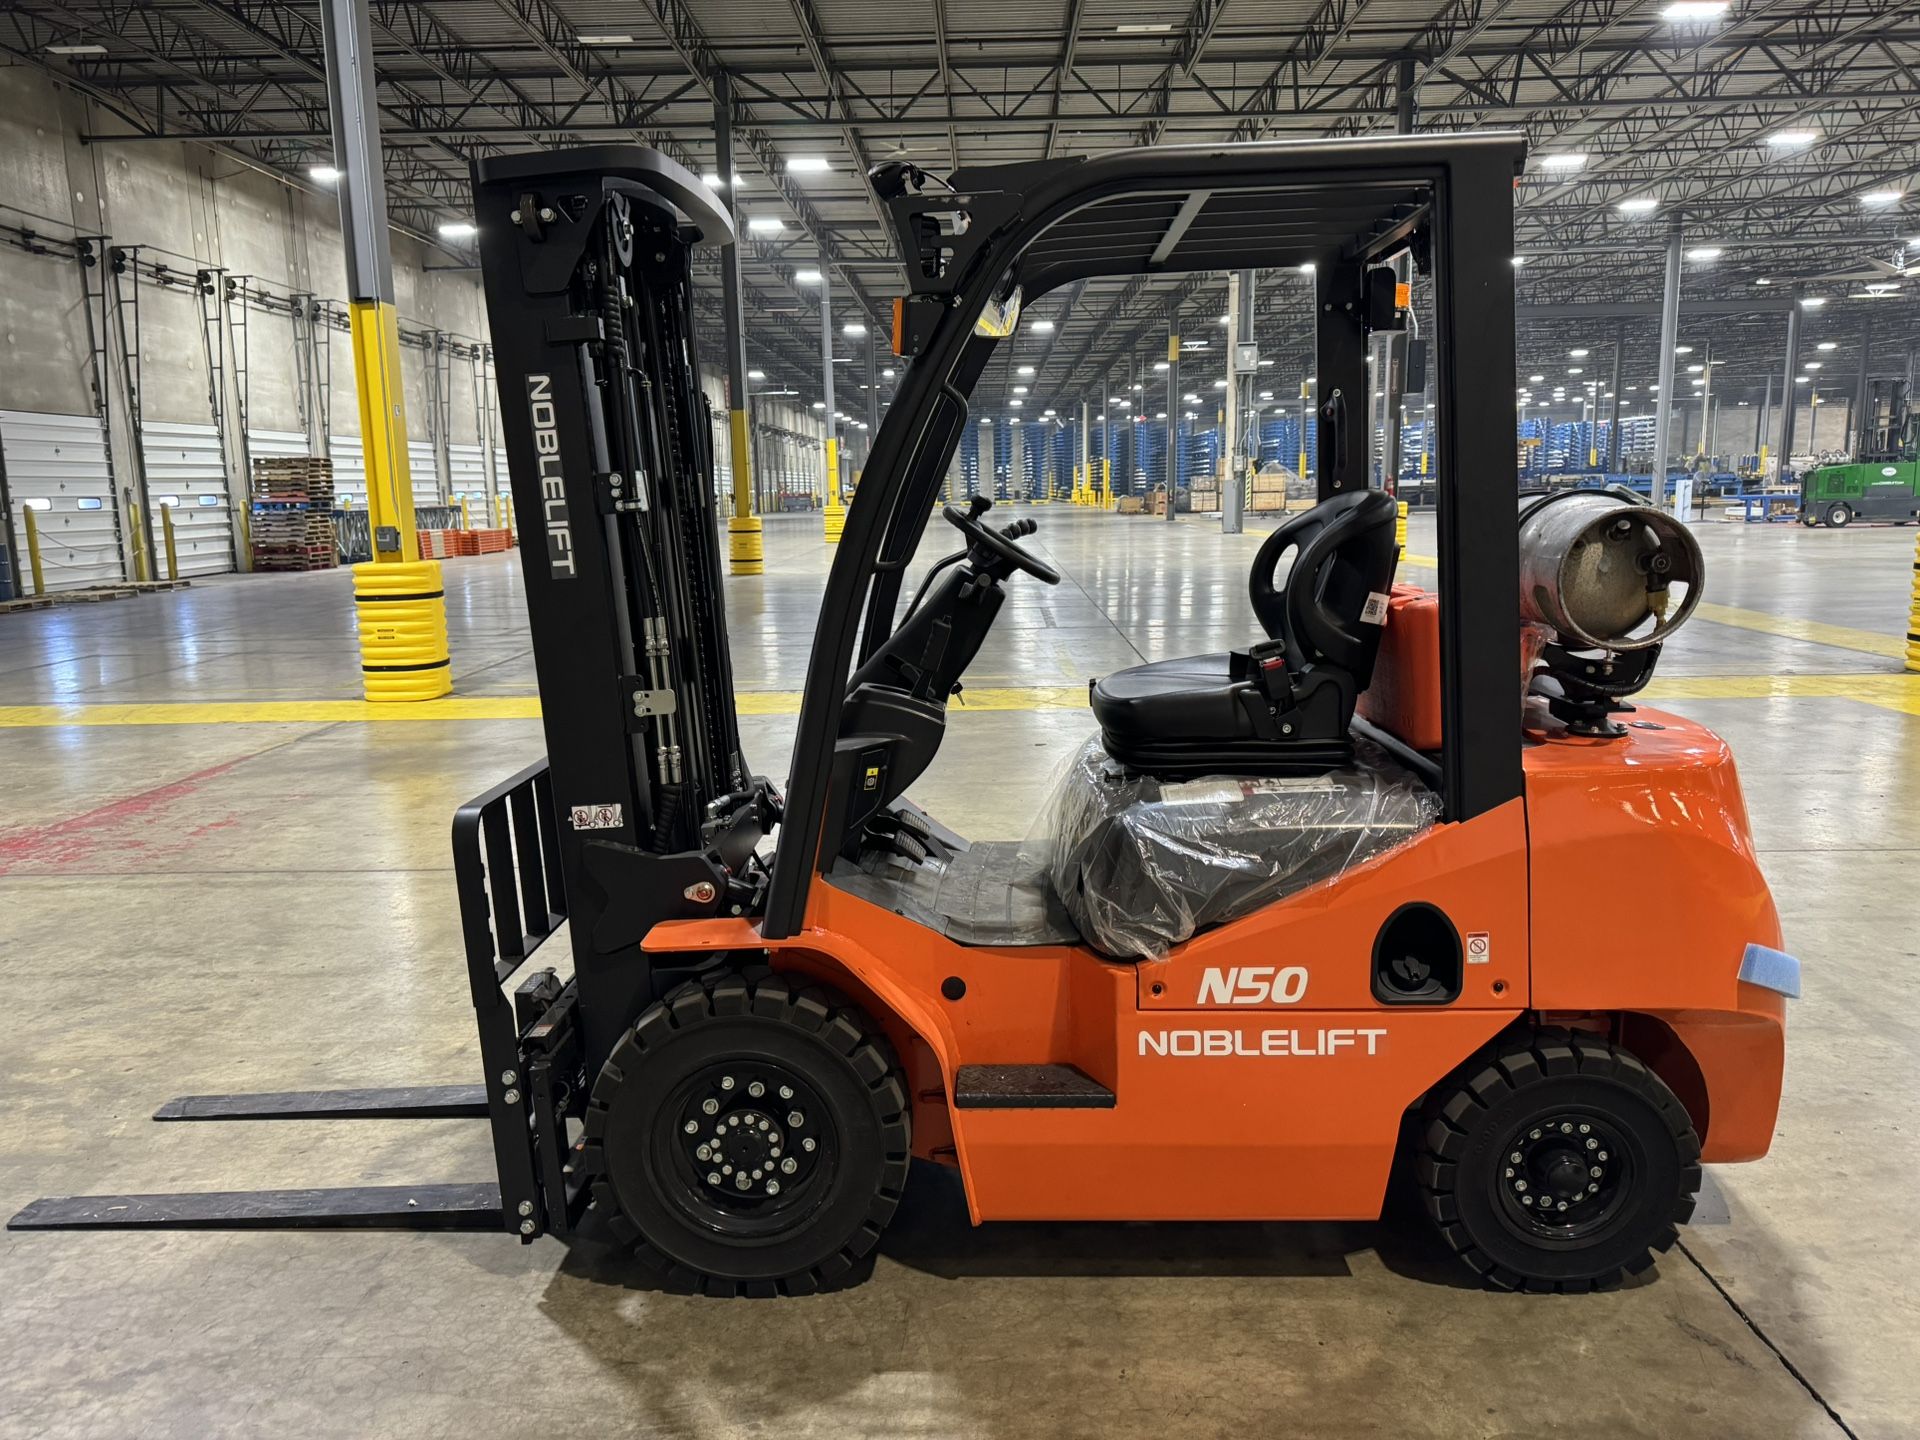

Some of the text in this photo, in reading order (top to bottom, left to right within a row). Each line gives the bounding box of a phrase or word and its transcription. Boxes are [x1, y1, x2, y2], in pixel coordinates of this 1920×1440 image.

[528, 375, 575, 575] NOBLELIFT
[1197, 966, 1308, 1004] N50
[1138, 1029, 1387, 1056] NOBLELIFT
